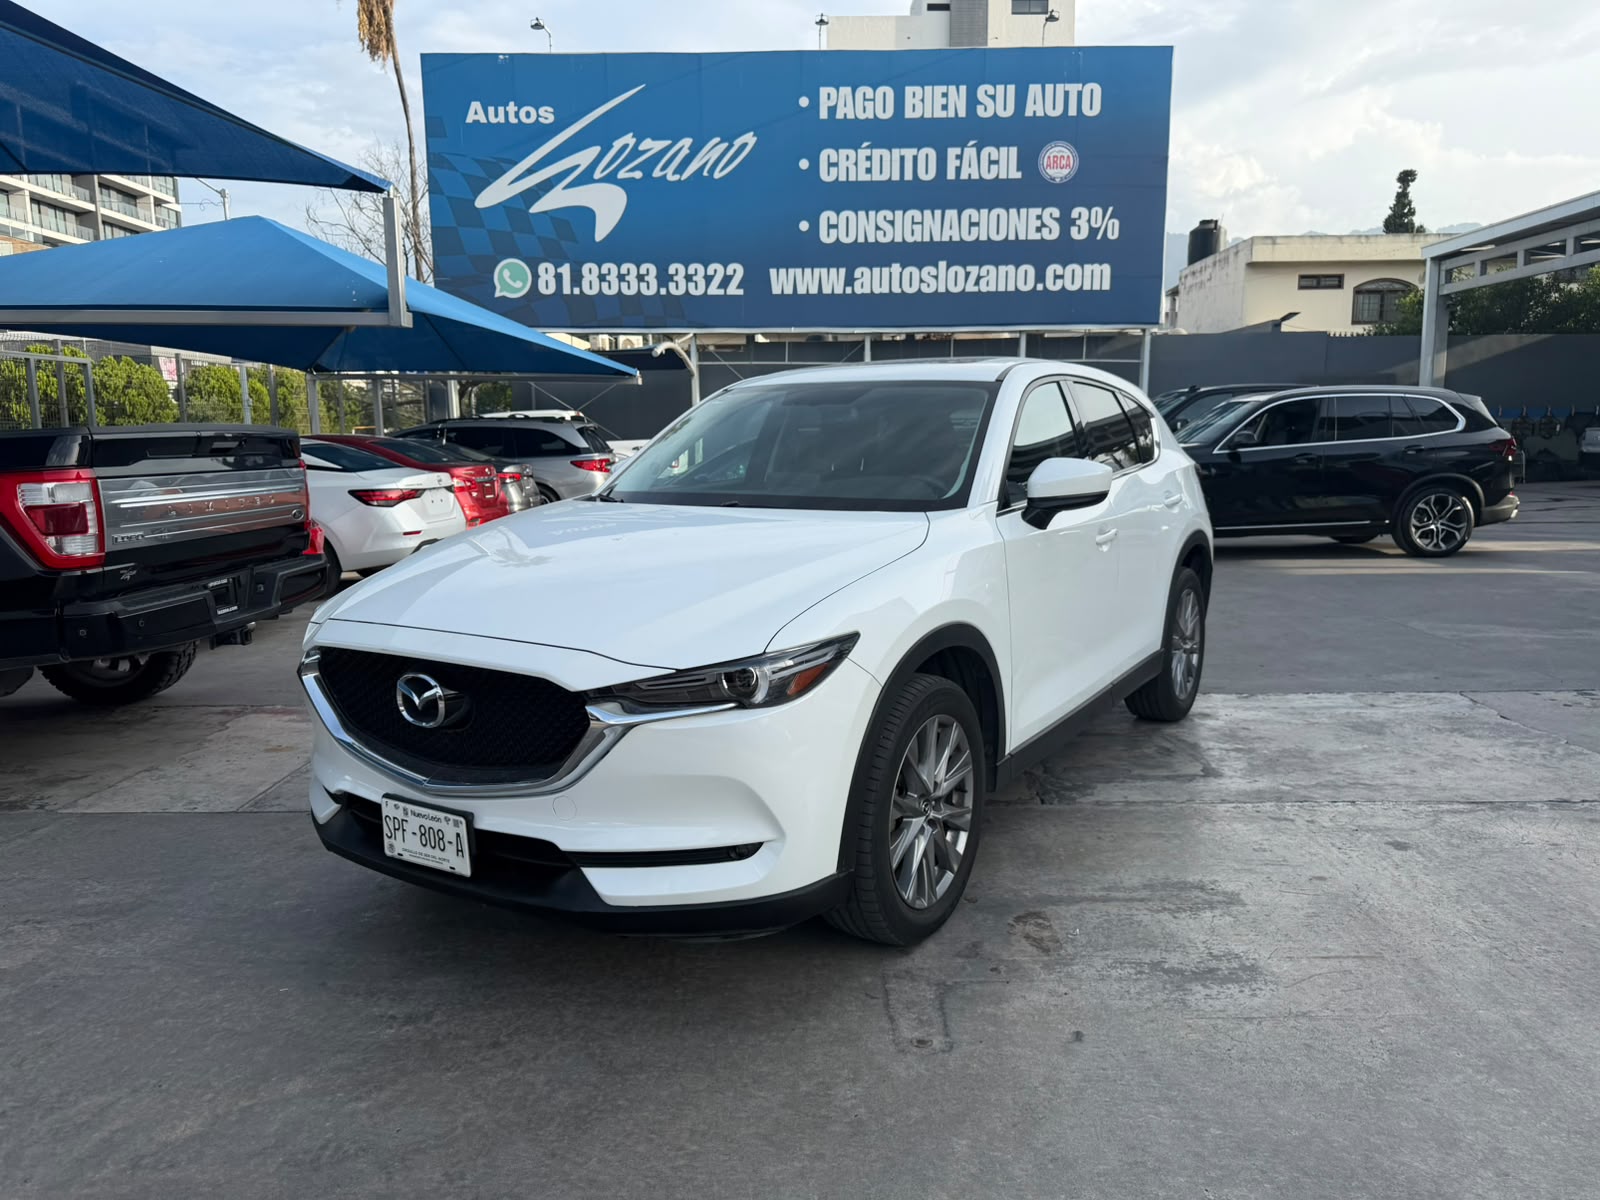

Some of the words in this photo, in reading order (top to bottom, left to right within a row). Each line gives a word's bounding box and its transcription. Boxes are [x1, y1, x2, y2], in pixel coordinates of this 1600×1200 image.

[465, 100, 555, 124] Autos
[818, 86, 895, 120] PAGO
[904, 85, 967, 119] BIEN
[976, 84, 1016, 118] SU
[1024, 82, 1102, 117] AUTO
[474, 83, 758, 243] Lozano
[818, 142, 937, 183] CRÉDITO
[946, 140, 1022, 180] FÁCIL
[1046, 155, 1071, 170] ARCA
[818, 208, 1061, 244] CONSIGNACIONES
[1070, 206, 1120, 241] 3%
[537, 263, 745, 296] 81.8333.3322
[769, 260, 1112, 295] www.autoslozano.com
